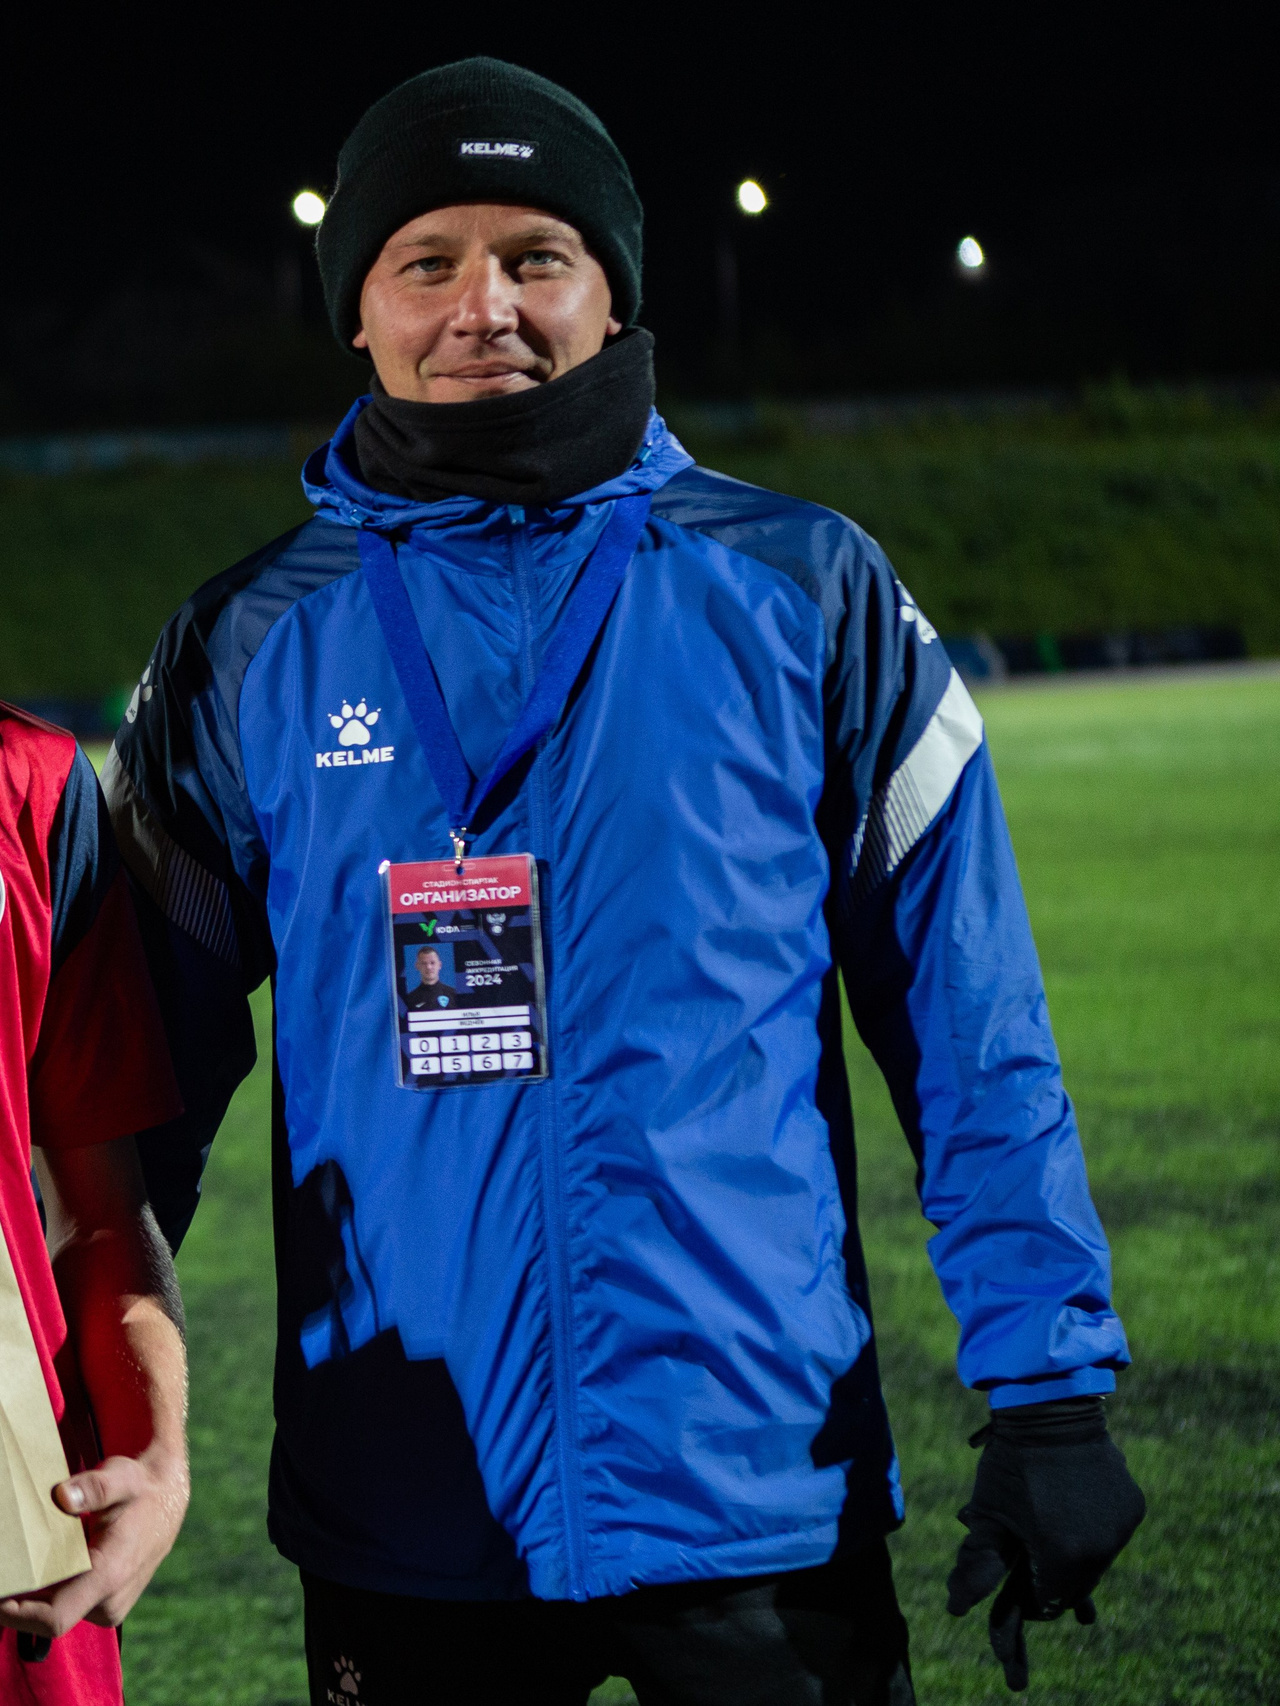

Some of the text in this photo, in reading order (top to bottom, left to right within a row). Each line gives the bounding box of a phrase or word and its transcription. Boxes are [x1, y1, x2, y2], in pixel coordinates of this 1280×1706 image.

[461, 142, 520, 156] KELME
[316, 746, 395, 768] KELME
[462, 877, 499, 886] СПАРТАК
[400, 886, 522, 906] ОРГАНИЗАТОР
[465, 973, 503, 987] 2024
[419, 1034, 522, 1053] 0 1 2 3
[421, 1054, 523, 1072] 4 5 6 7
